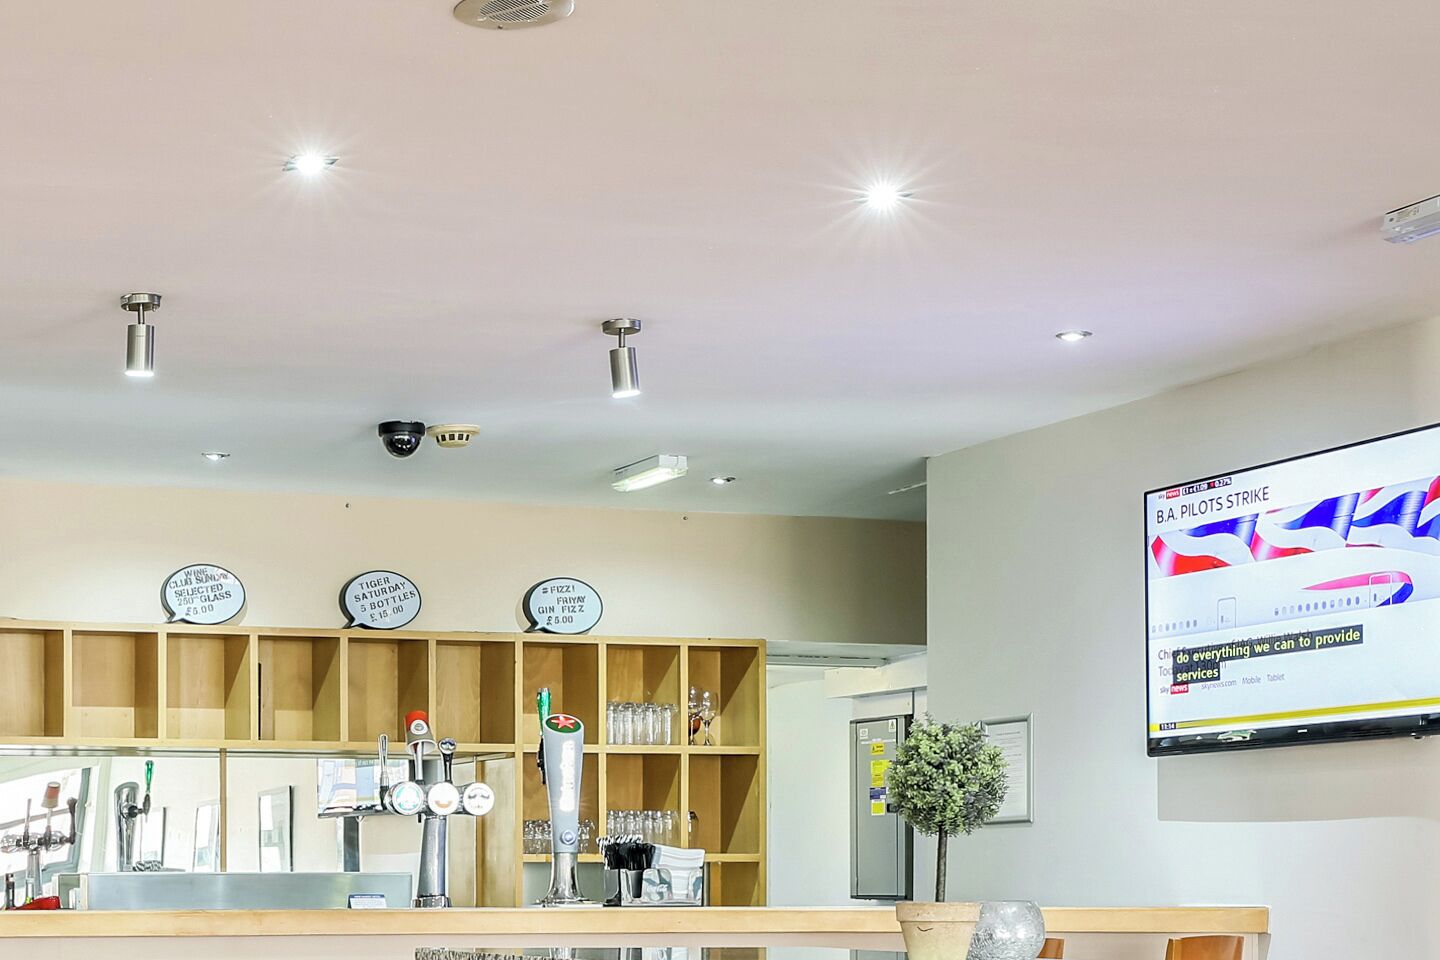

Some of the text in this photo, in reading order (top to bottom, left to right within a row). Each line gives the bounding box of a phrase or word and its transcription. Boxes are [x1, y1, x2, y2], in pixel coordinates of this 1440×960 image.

[1156, 486, 1269, 524] B.A. PILOTS STRIKE
[359, 576, 390, 590] TIGER
[175, 583, 223, 598] SELECTED
[200, 591, 232, 603] GLASS
[354, 582, 406, 602] SATURDAY
[370, 590, 416, 610] BOTTLES
[538, 605, 584, 614] GIN FIZZ
[1176, 629, 1360, 663] do everything we can to provide
[1176, 667, 1219, 681] services
[1242, 674, 1261, 685] Mobile
[1267, 673, 1285, 681] Tablet
[1171, 684, 1188, 693] news
